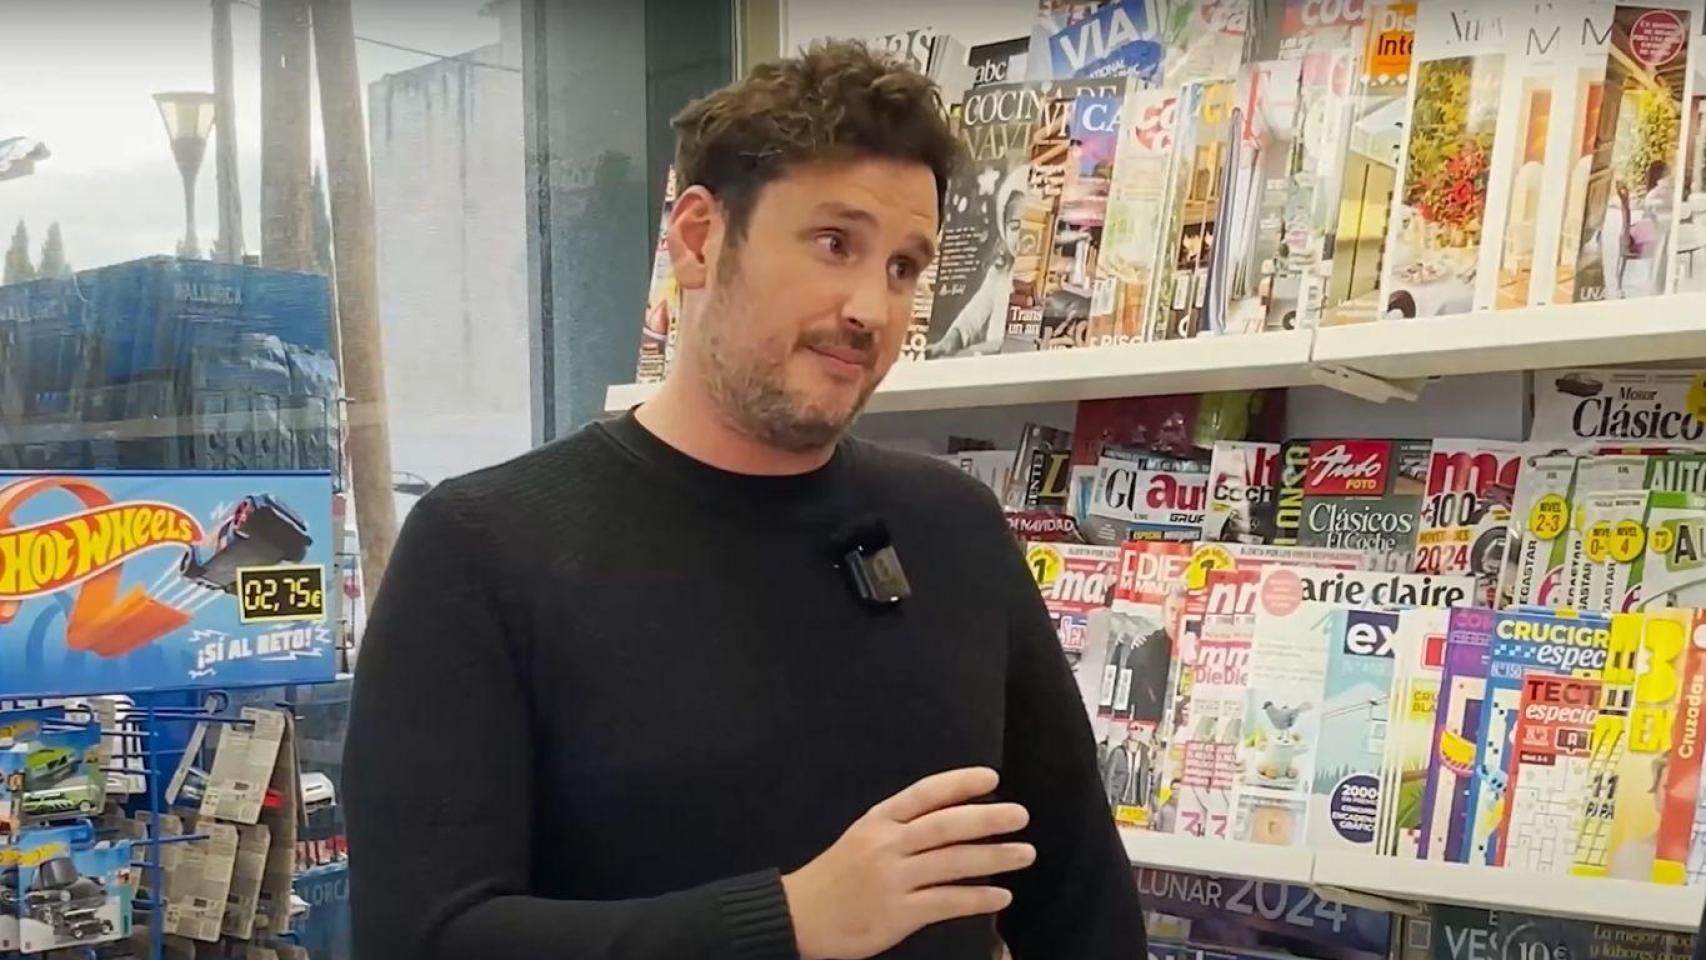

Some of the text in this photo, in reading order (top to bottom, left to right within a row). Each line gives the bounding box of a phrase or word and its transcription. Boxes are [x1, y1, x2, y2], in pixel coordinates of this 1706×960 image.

[1309, 502, 1413, 533] Clásicos
[1299, 572, 1365, 605] arie
[1371, 571, 1465, 608] claire
[1137, 867, 1223, 908] LUNAR
